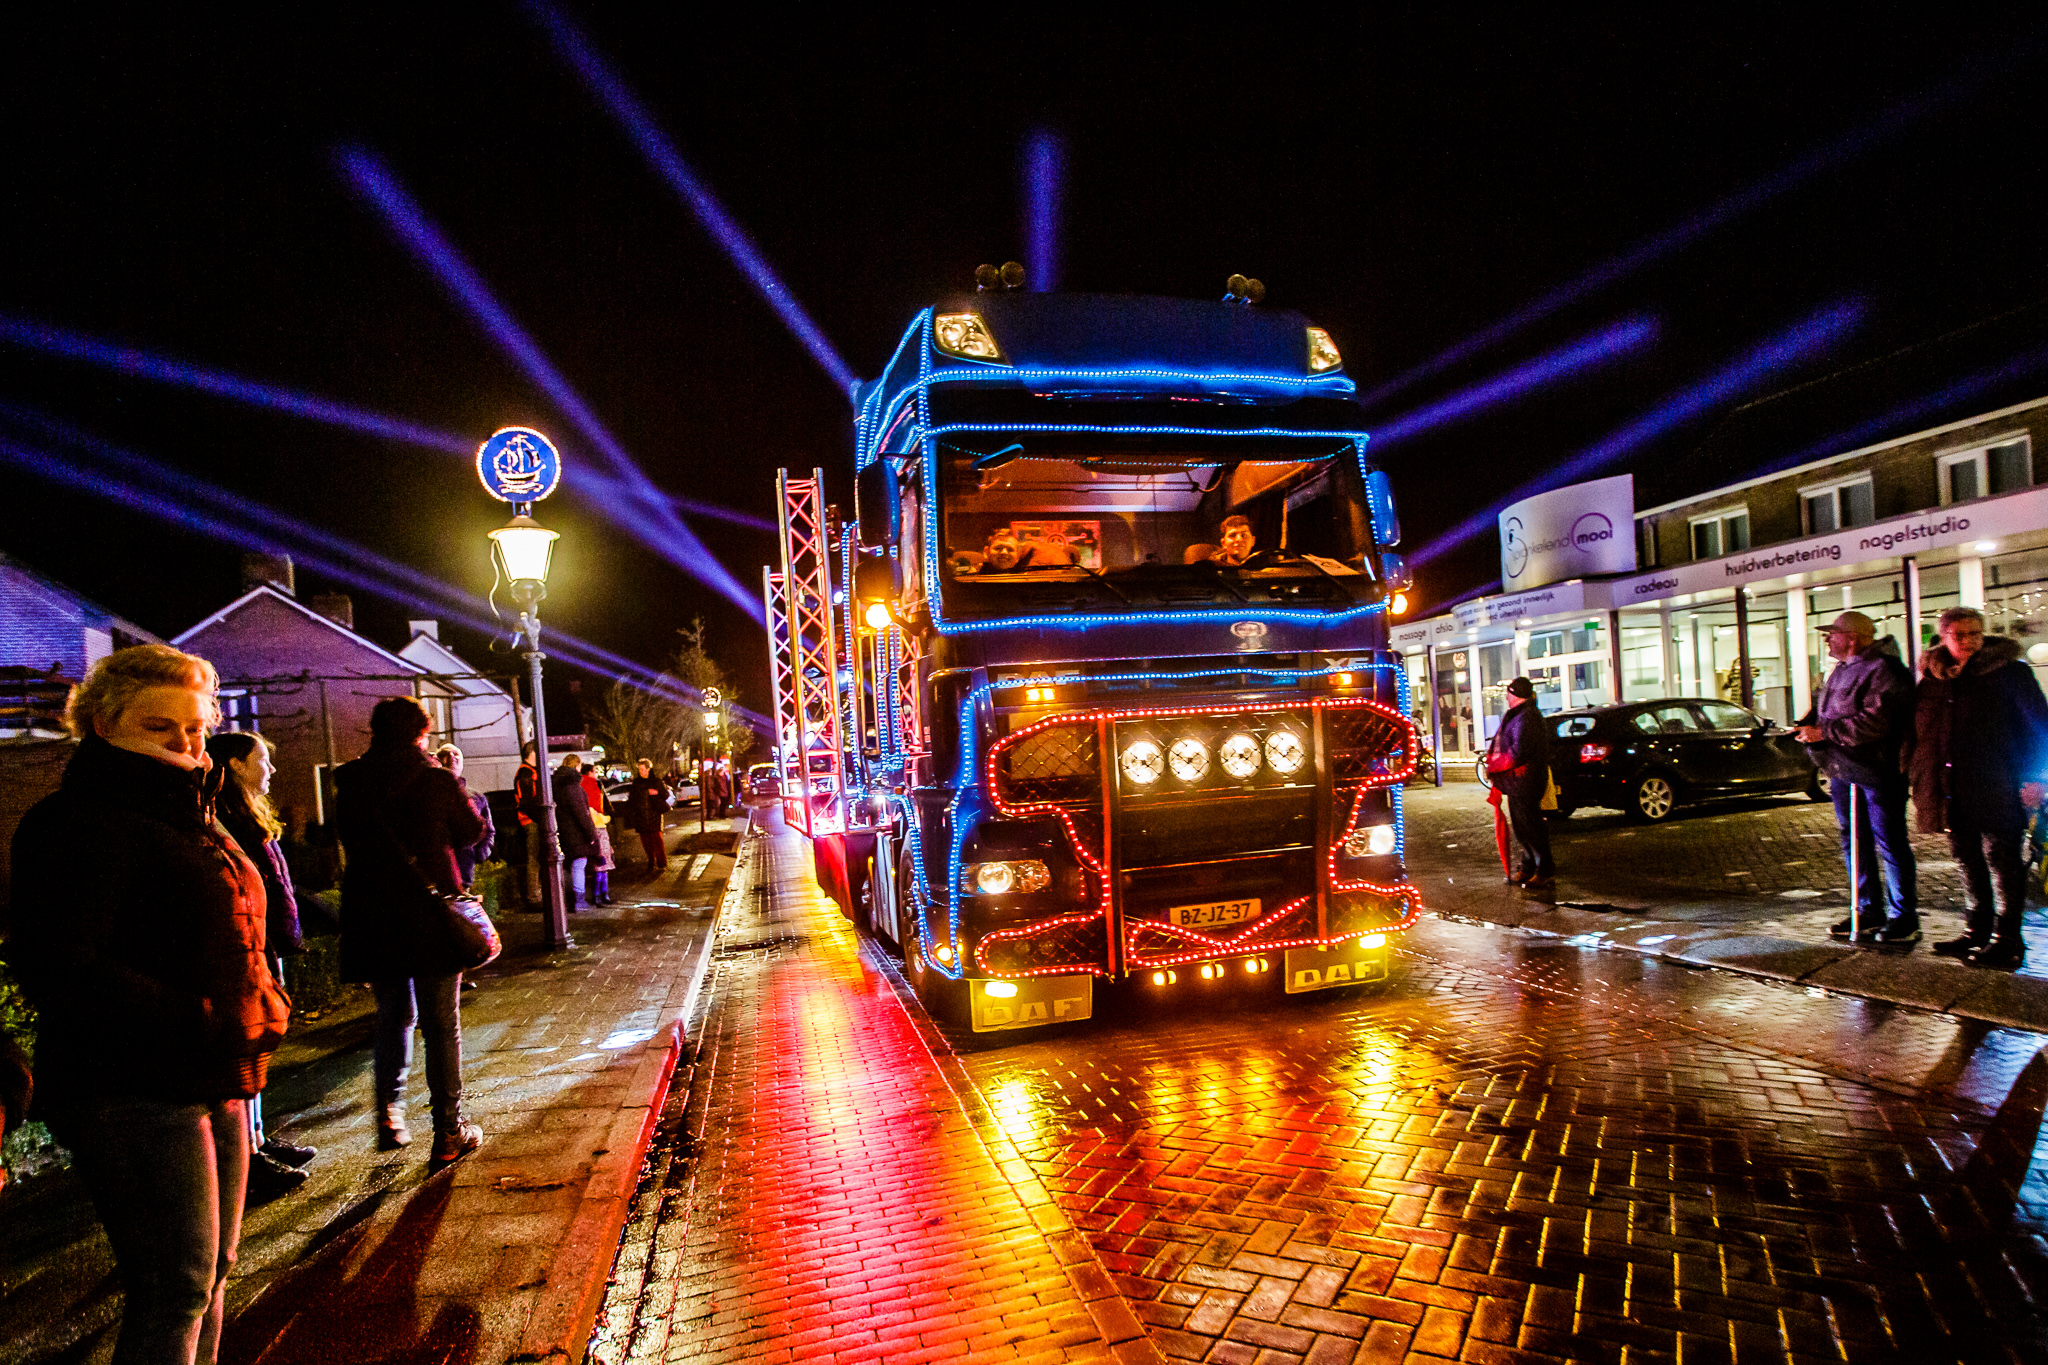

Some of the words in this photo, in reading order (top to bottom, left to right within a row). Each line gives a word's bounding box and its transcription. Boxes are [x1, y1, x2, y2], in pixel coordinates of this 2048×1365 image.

[1635, 577, 1679, 594] cadeau
[1725, 543, 1842, 577] huidverbetering
[1859, 516, 1970, 550] nagelstudio
[1399, 629, 1427, 640] massage
[1180, 902, 1251, 926] BZ-JZ-37
[1295, 960, 1380, 988] DAF
[983, 997, 1083, 1027] DAF
